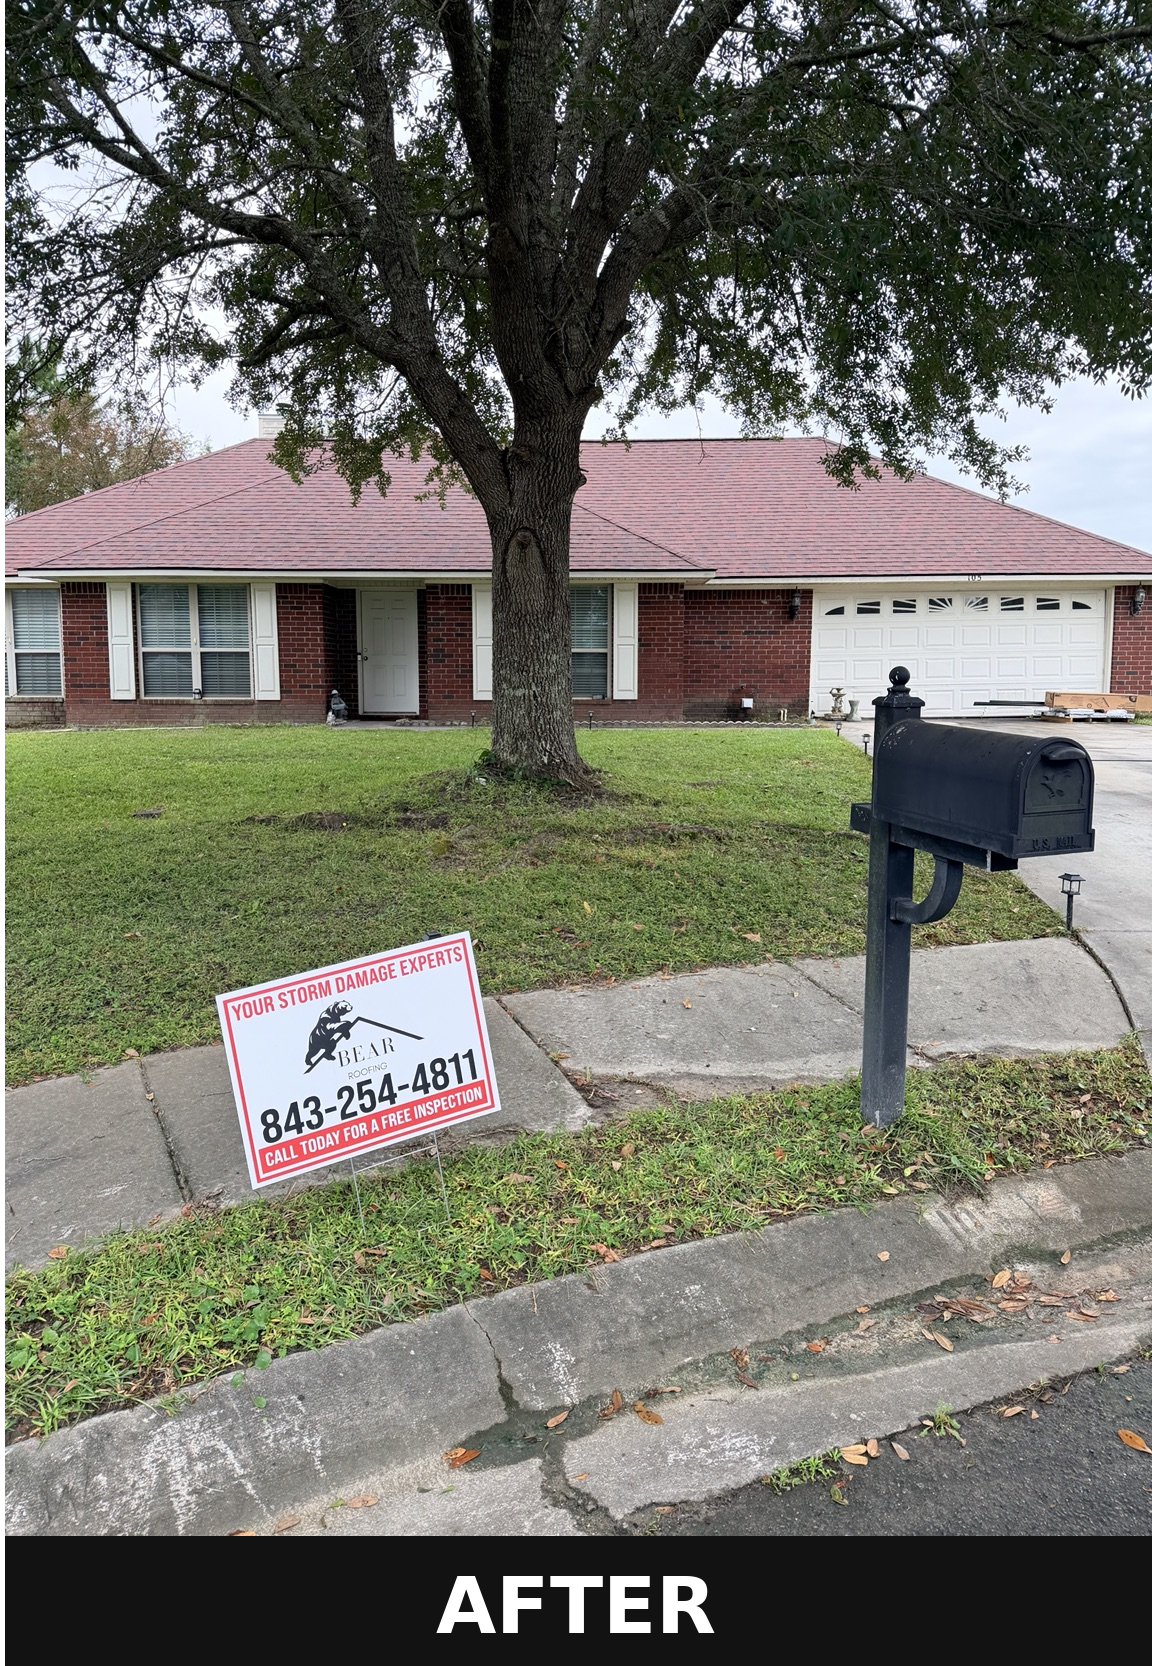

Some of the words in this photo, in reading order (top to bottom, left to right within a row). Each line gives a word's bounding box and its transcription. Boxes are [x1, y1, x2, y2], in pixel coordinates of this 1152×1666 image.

[231, 995, 275, 1021] YOUR
[279, 980, 333, 1009] STORM
[335, 963, 398, 994] DAMAGE
[399, 946, 463, 976] EXPERTS
[336, 1037, 396, 1068] BEAR
[347, 1062, 389, 1080] ROOFING
[260, 1048, 478, 1144] 843-254-4811
[264, 1145, 299, 1168] CALL
[299, 1131, 341, 1157] TODAY
[343, 1122, 369, 1143] FOR
[370, 1120, 380, 1134] A
[381, 1112, 412, 1131] FREE
[413, 1086, 484, 1120] INSPECTION
